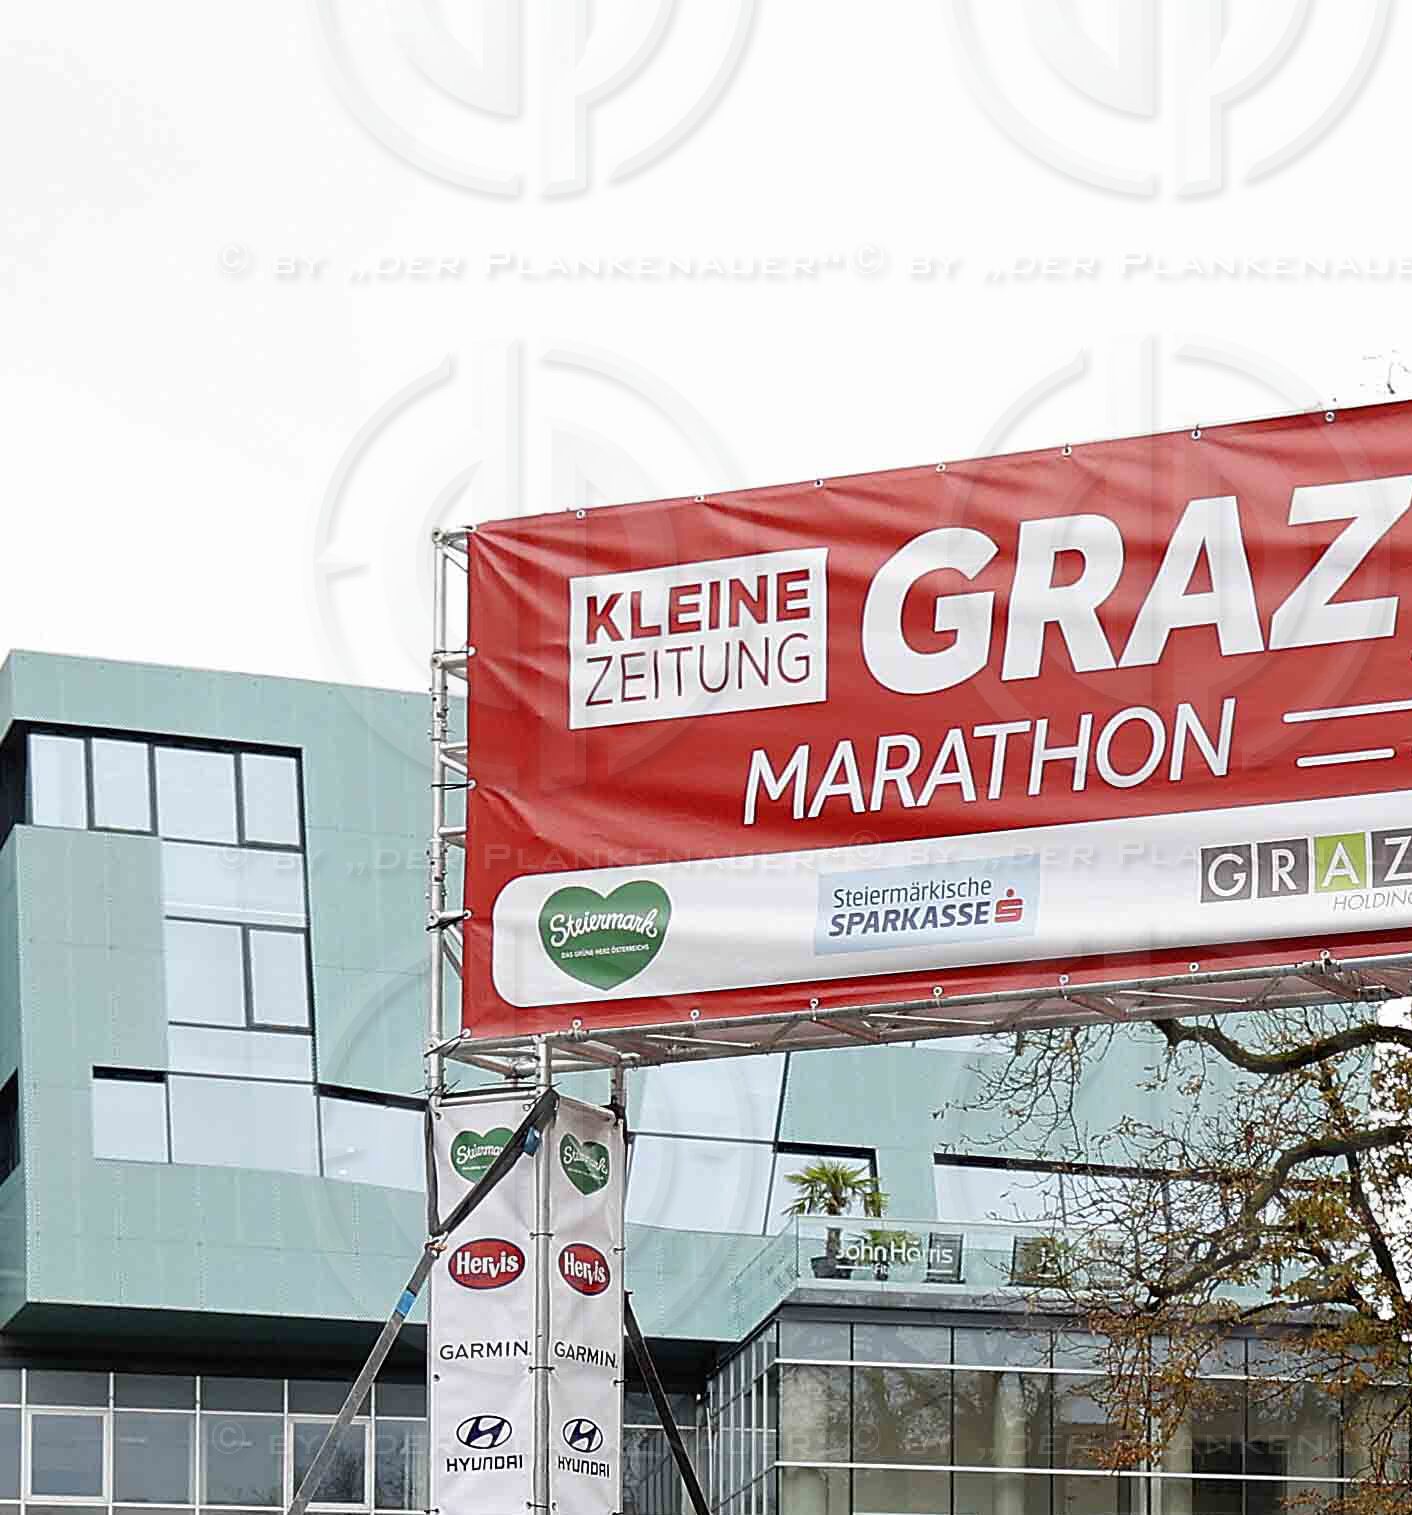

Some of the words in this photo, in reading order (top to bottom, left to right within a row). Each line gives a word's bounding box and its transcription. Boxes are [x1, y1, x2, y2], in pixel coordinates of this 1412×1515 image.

[584, 567, 812, 646] KLEINE
[584, 632, 811, 708] ZEITUNG
[741, 696, 1236, 825] MARATHON
[831, 877, 993, 910] Steiermärkische
[549, 908, 660, 948] Steiermark
[828, 900, 991, 938] SPARKASSE
[456, 1250, 520, 1281] Hervis
[563, 1251, 608, 1287] Hervis
[445, 1454, 524, 1473] HYUNDAI
[557, 1455, 611, 1479] HYUNDAI
